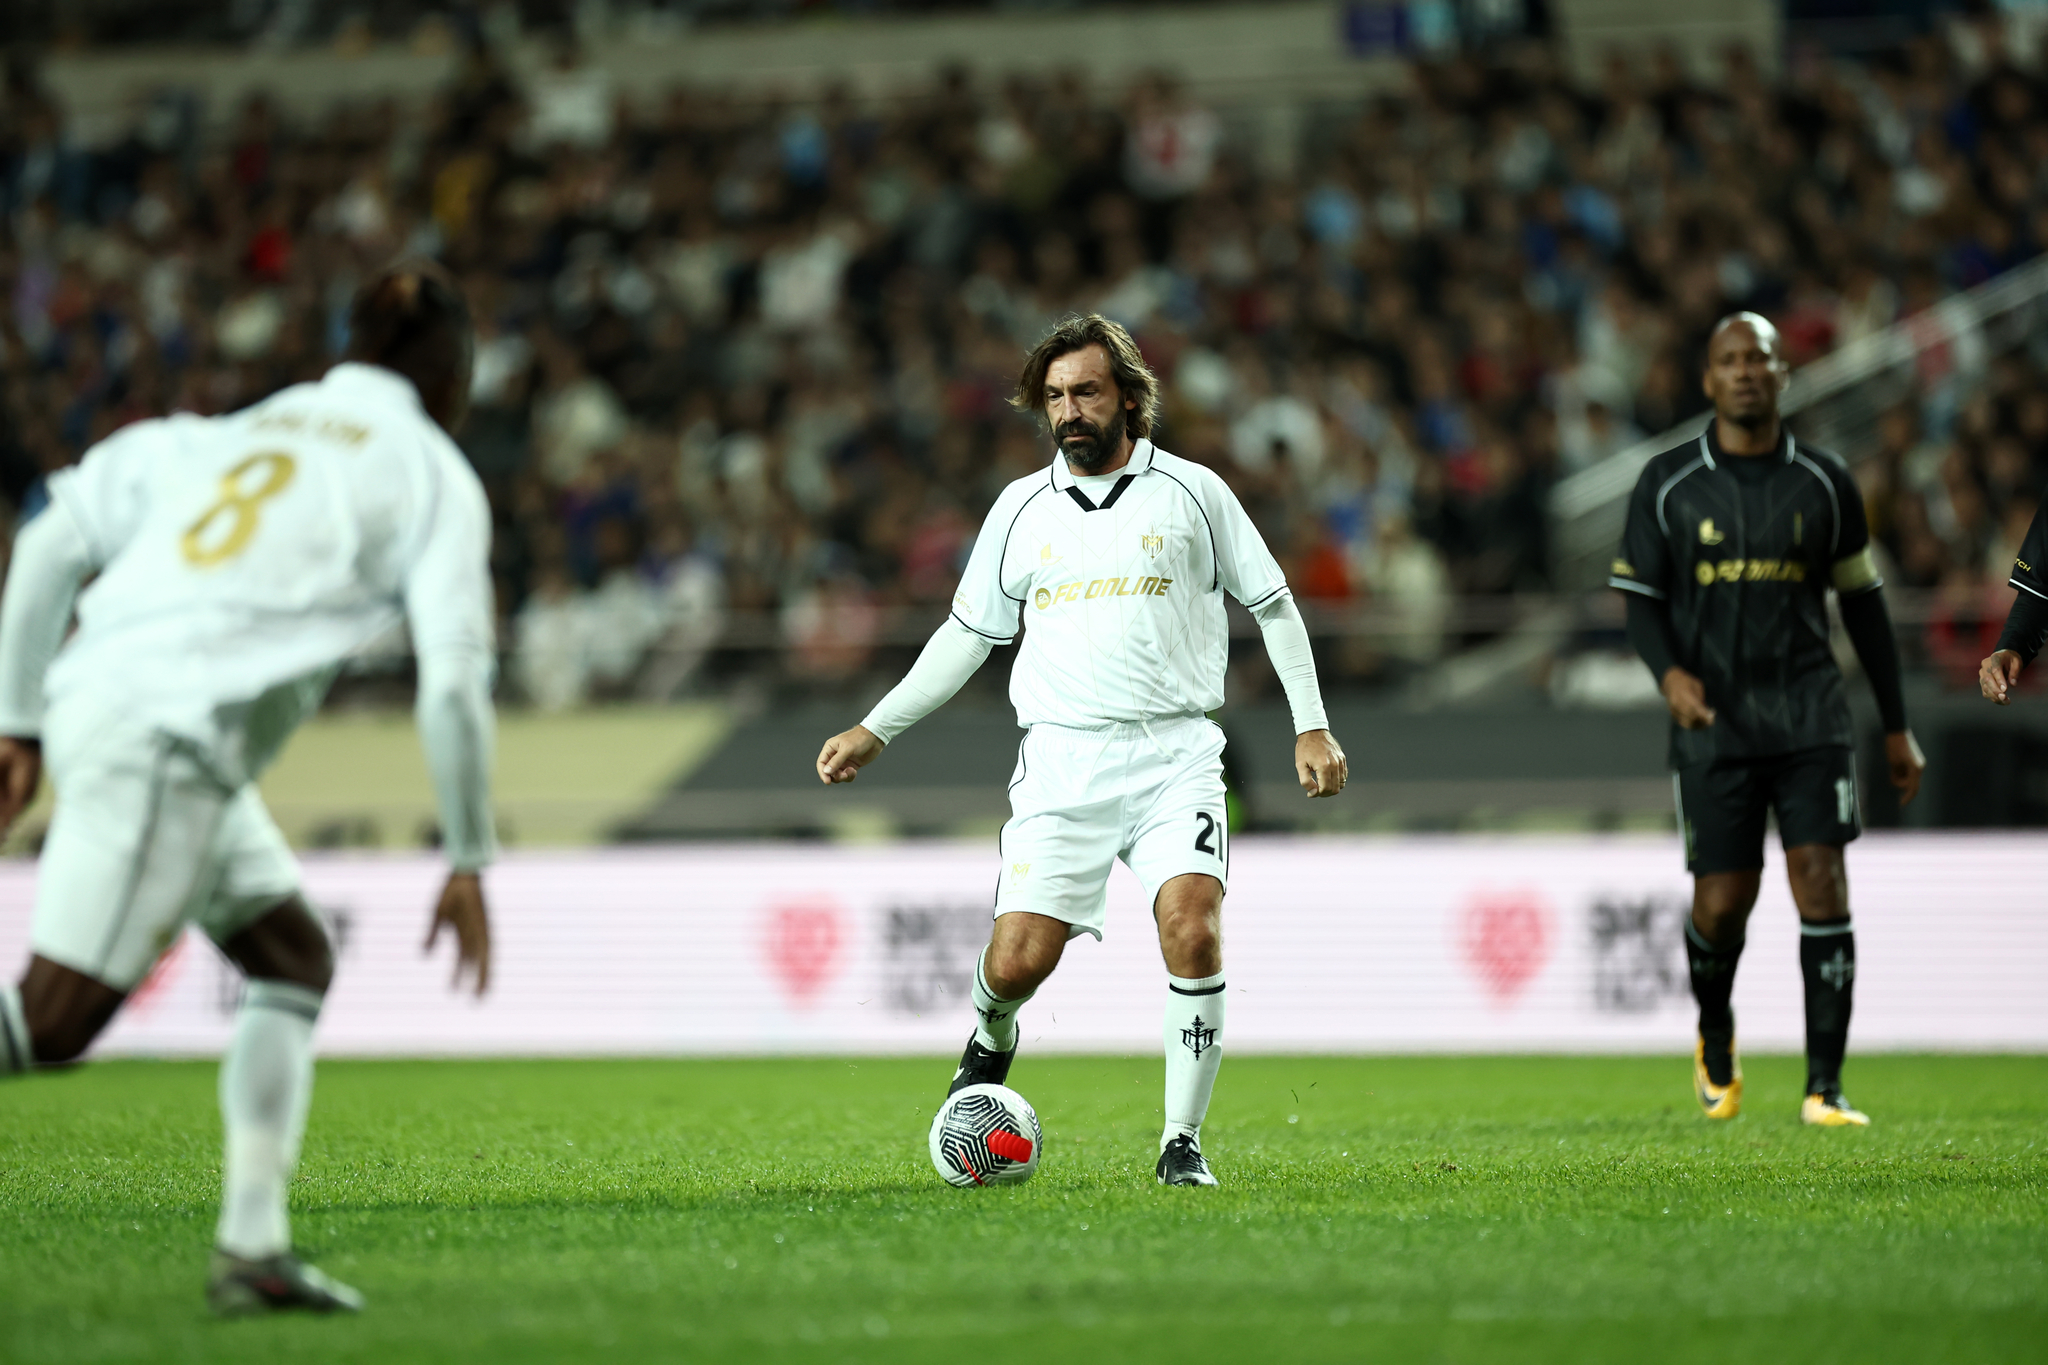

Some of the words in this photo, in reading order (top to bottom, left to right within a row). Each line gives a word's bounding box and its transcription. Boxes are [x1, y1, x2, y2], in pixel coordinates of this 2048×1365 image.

[181, 452, 296, 567] 8
[1052, 581, 1084, 605] FC
[1084, 576, 1174, 600] ONLINE
[1194, 811, 1224, 863] 21
